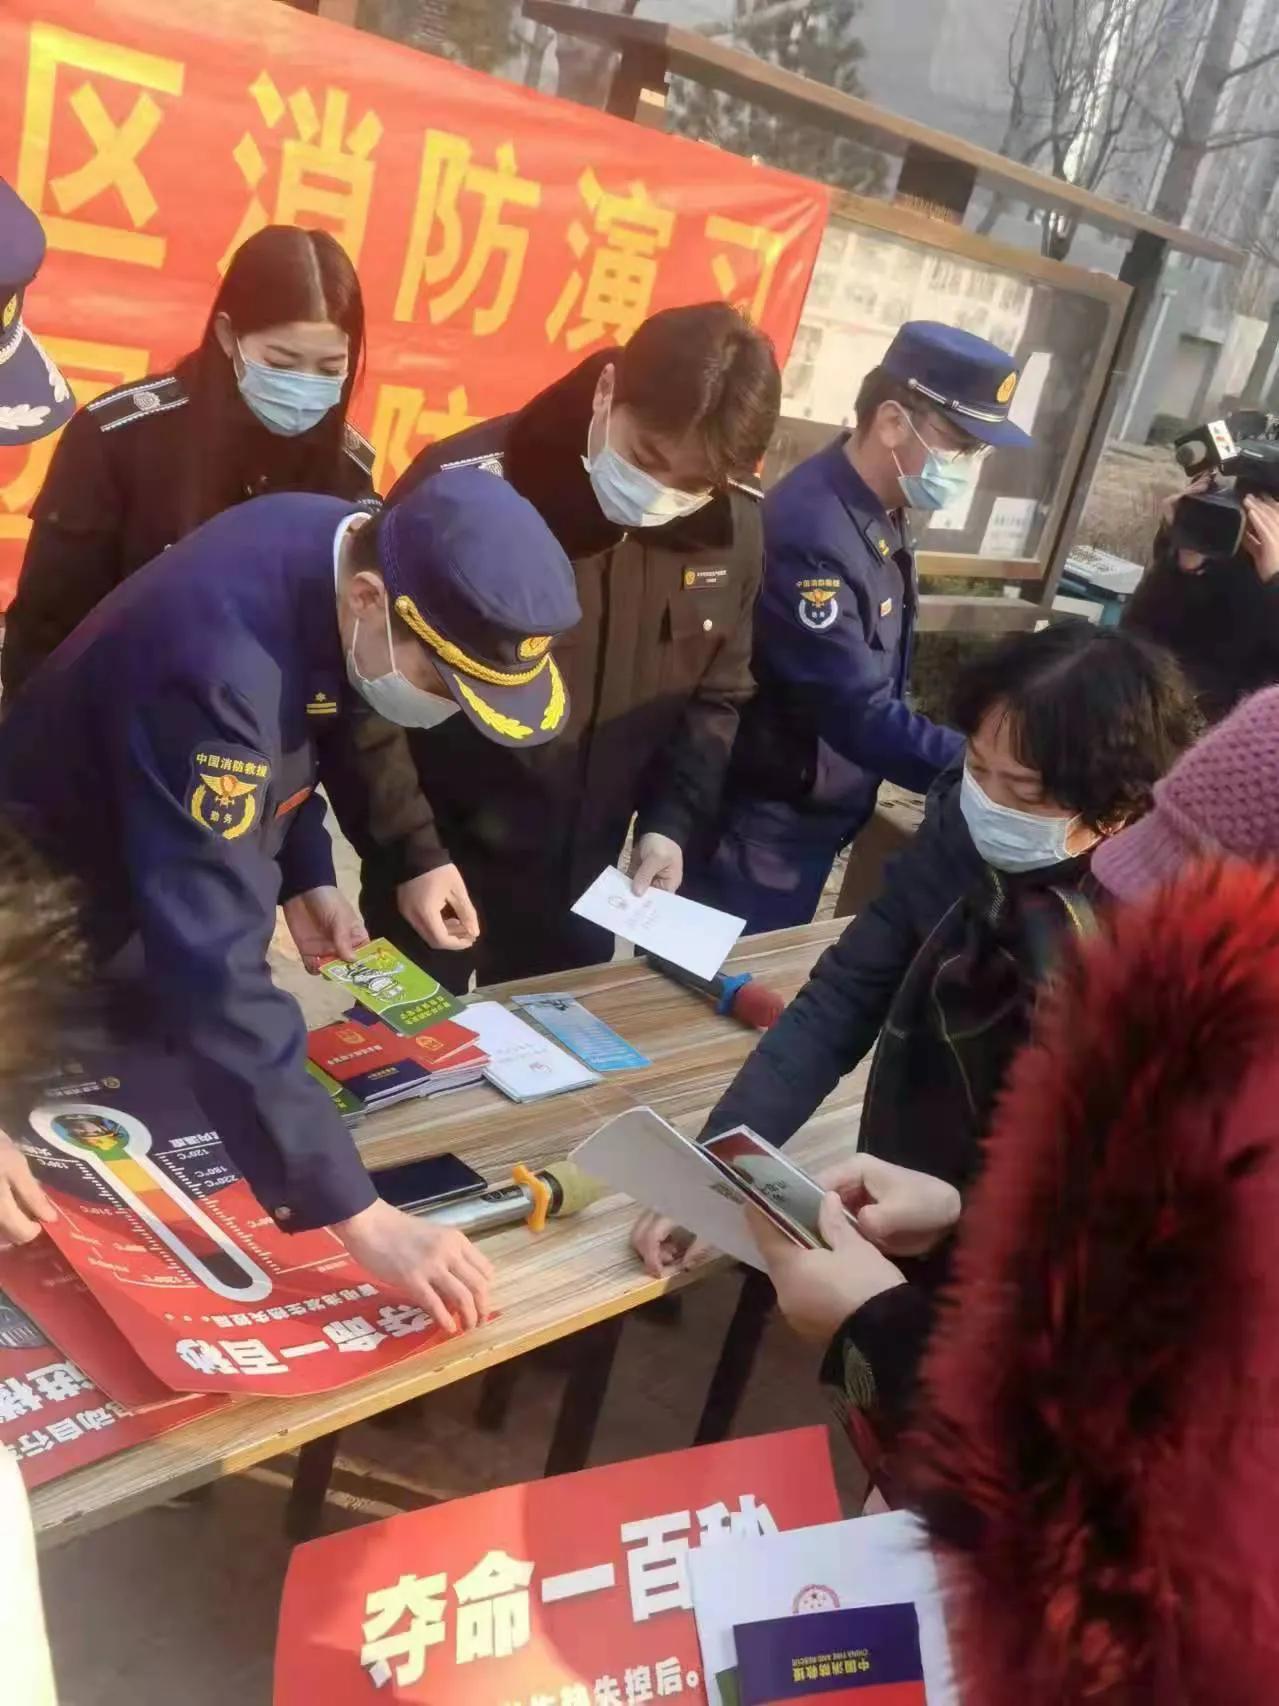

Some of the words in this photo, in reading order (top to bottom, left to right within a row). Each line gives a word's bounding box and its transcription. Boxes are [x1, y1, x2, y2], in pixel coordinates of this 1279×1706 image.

[17, 21, 785, 352] 区消防演习
[196, 752, 268, 778] 中国消防救援
[176, 1304, 434, 1376] 夺命一百秒
